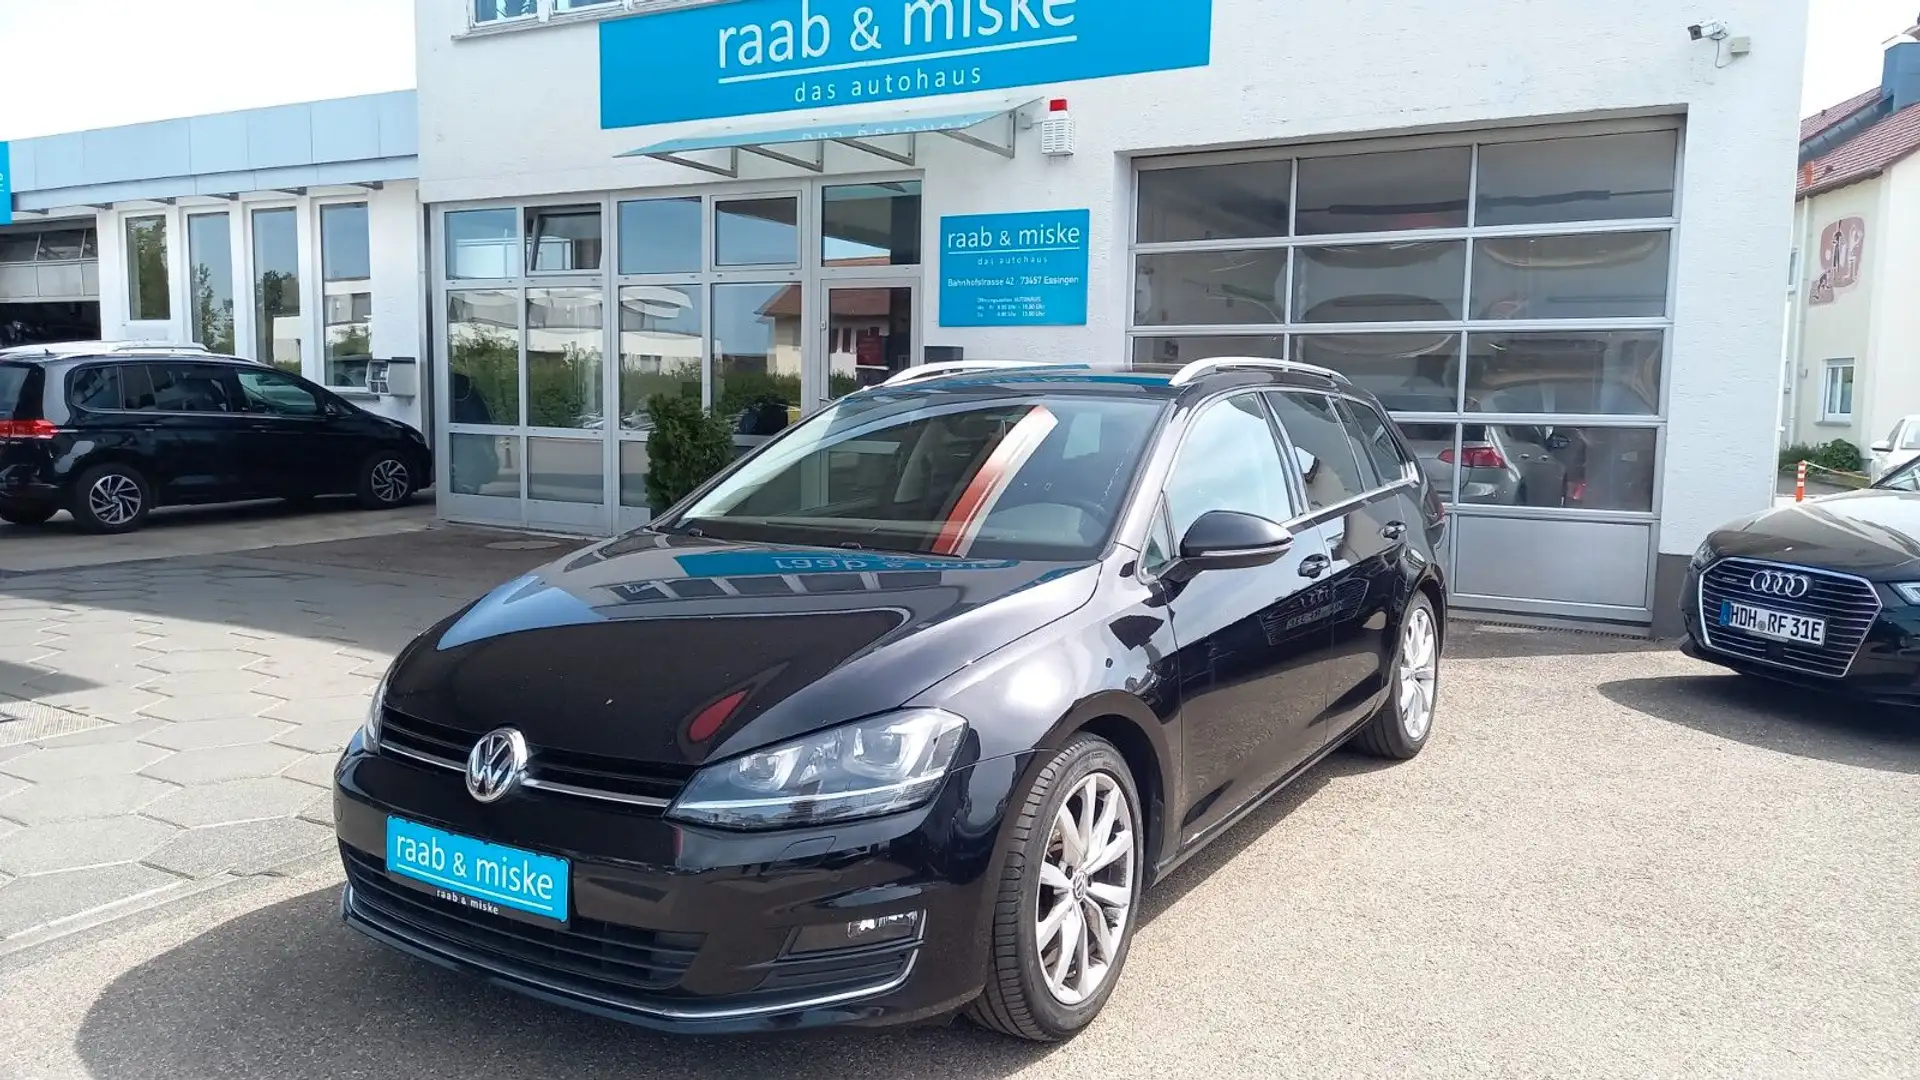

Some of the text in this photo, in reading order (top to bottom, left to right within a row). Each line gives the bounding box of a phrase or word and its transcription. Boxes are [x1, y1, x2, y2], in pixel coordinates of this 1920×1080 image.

[718, 0, 1076, 68] raab & miske
[794, 66, 982, 103] das autohaus
[948, 222, 1080, 249] raab & miske
[1000, 256, 1048, 265] autohaus
[1731, 604, 1822, 641] HDH RF 31E
[396, 835, 554, 900] raab & miske
[436, 889, 499, 915] raab & miske
